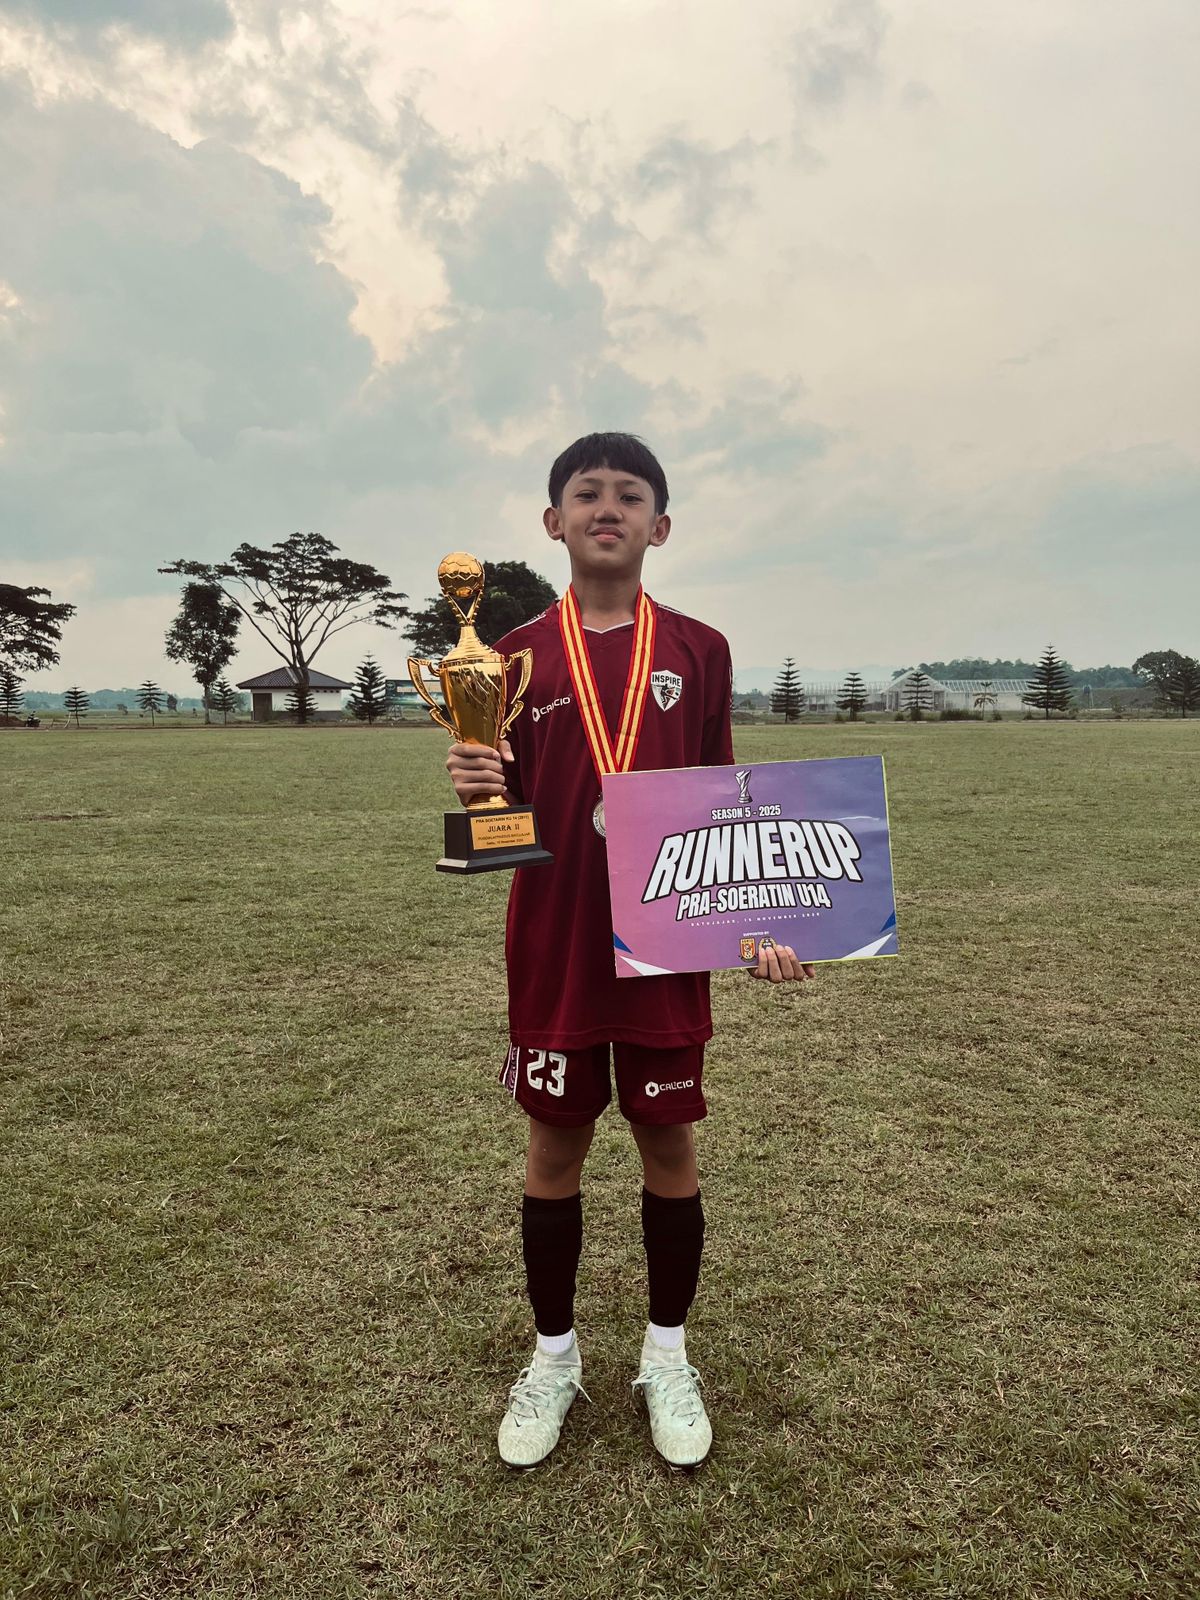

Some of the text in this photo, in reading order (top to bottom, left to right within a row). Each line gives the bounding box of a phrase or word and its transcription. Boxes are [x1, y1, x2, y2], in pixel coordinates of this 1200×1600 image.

[652, 674, 681, 687] INSPIRE
[711, 807, 743, 820] SEASON
[744, 806, 752, 818] 5
[758, 804, 782, 817] 2025
[641, 819, 864, 904] RUNNERUP
[675, 882, 832, 921] PRA-SOERATIN U14
[526, 1048, 568, 1097] 23
[659, 1079, 694, 1091] CALCIO
